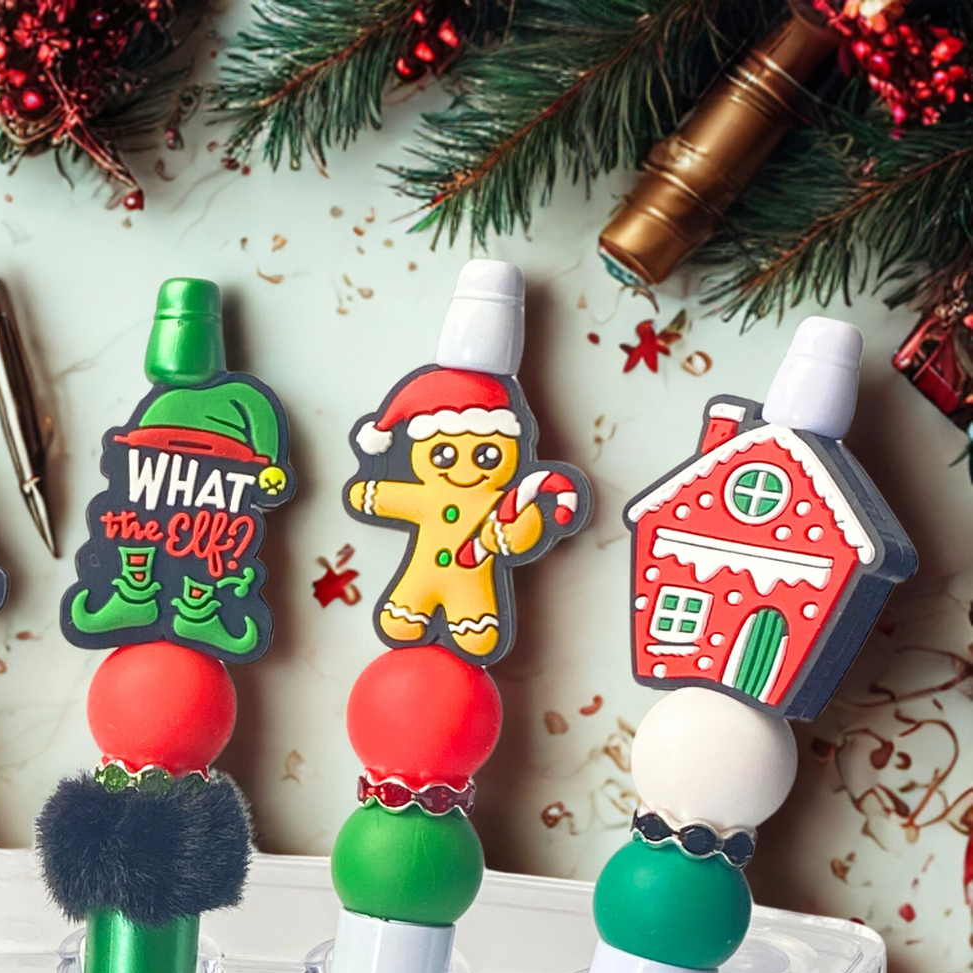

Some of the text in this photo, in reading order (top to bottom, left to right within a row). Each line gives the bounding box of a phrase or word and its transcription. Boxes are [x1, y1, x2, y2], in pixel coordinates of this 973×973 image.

[128, 448, 256, 514] WHAT
[100, 510, 255, 578] the Elf?
